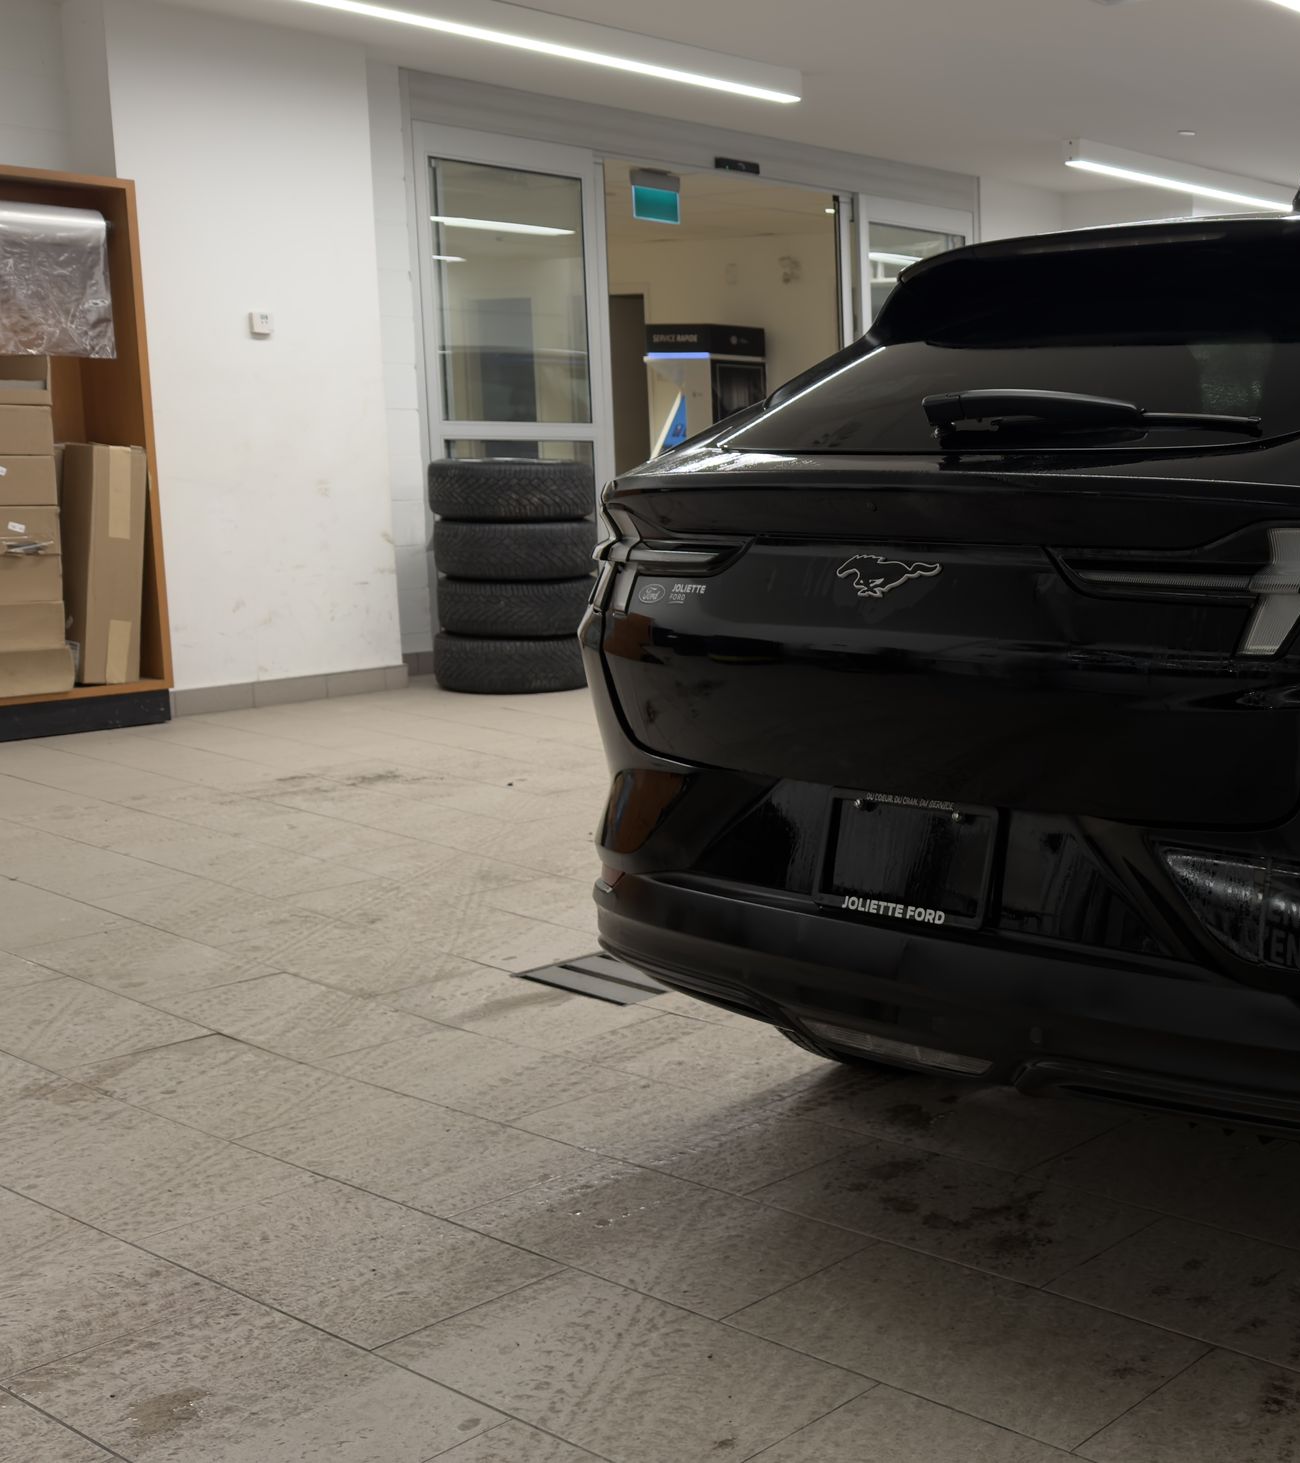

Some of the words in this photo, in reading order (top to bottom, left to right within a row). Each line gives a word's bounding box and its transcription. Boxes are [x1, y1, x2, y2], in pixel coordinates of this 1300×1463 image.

[672, 583, 706, 594] JOLIETTE
[841, 895, 904, 918] JOLIETTE
[906, 905, 946, 925] FORD
